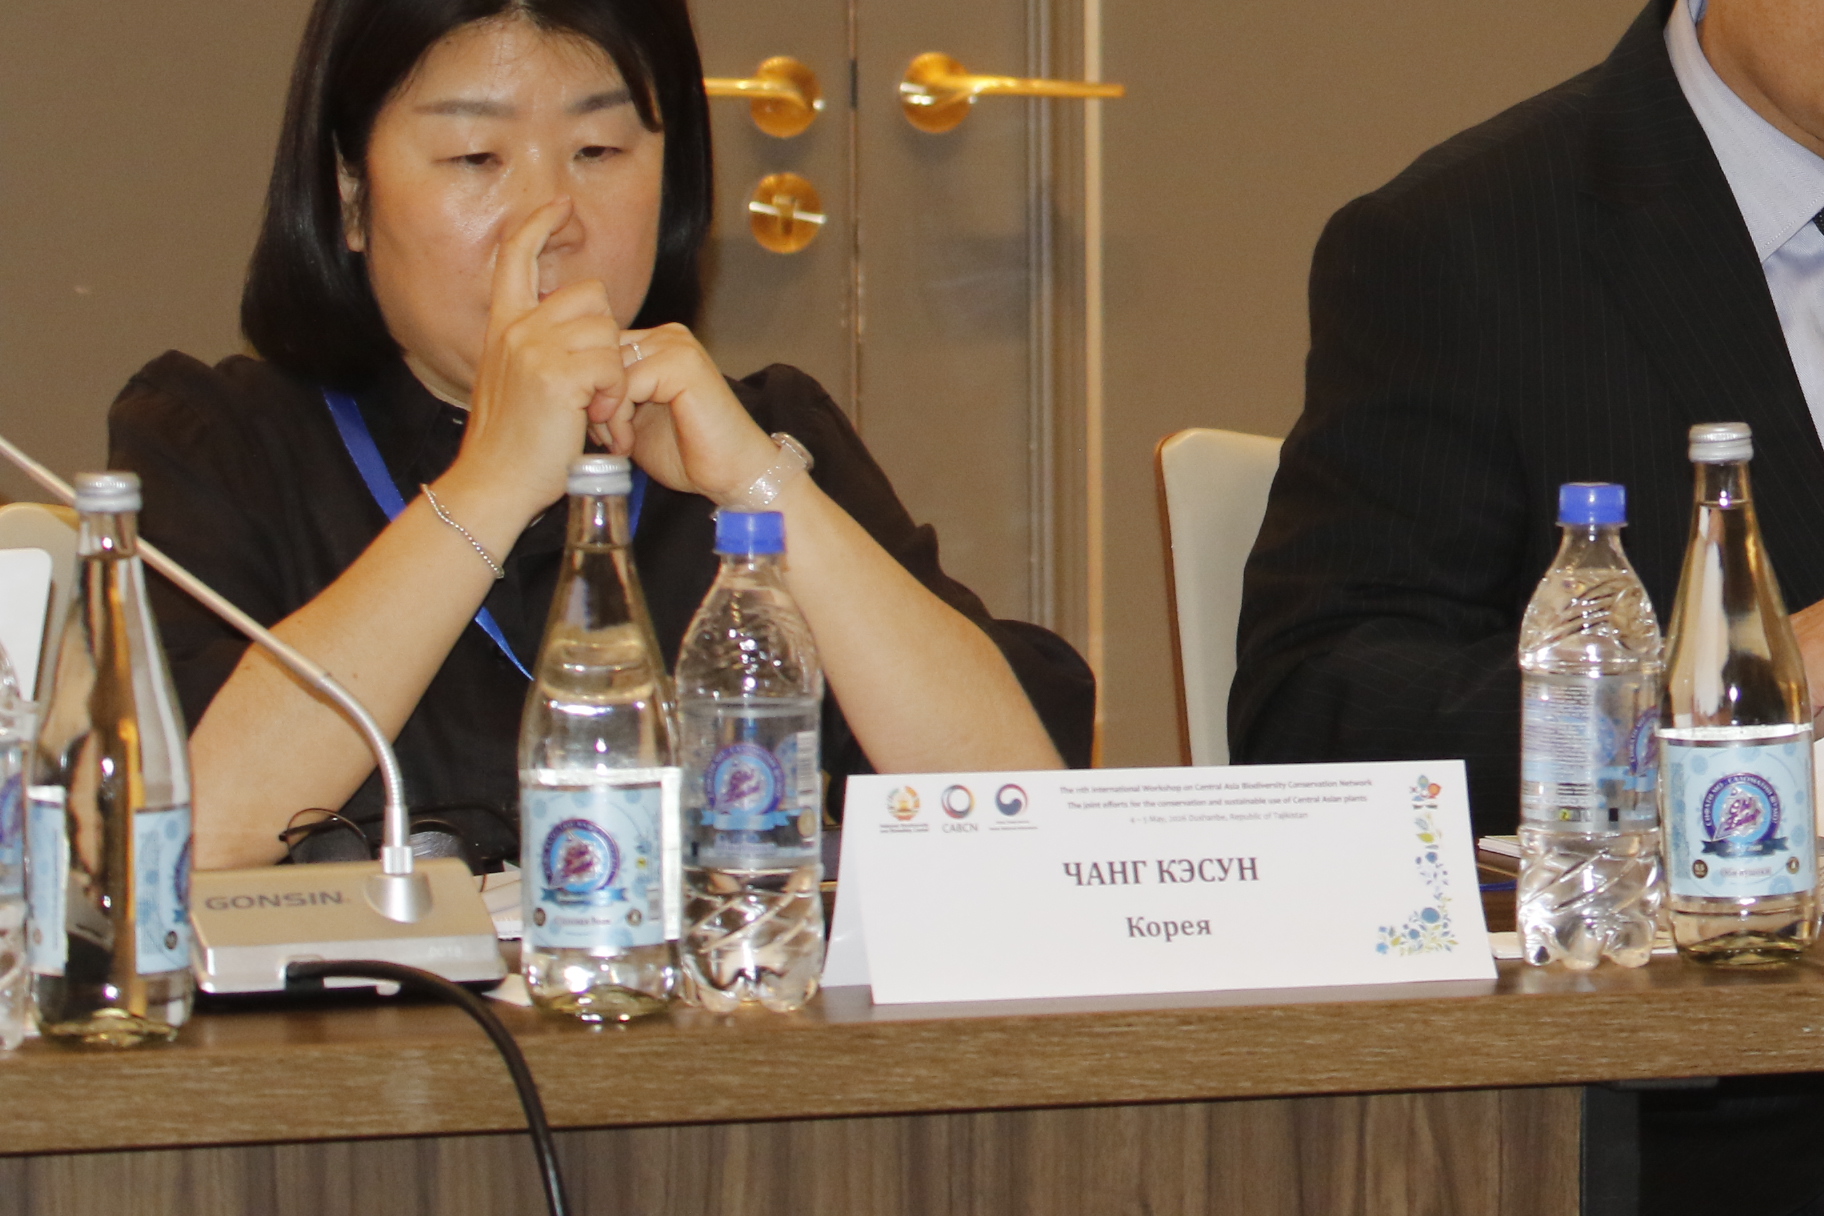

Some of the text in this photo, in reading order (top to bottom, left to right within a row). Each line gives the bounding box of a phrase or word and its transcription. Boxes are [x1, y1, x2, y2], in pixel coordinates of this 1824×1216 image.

[1143, 784, 1182, 793] Workshop
[1194, 783, 1222, 791] Central
[1288, 780, 1338, 789] Conservation
[1339, 779, 1373, 787] Network
[1067, 801, 1082, 809] The
[1208, 798, 1222, 806] and
[1283, 796, 1292, 804] of
[1292, 795, 1320, 804] Central
[1343, 794, 1368, 804] plants
[942, 823, 979, 834] CABCN
[1062, 855, 1260, 887] ЧАНГ КЭСУН
[205, 891, 344, 911] GONSIN
[1125, 915, 1212, 943] Корея
